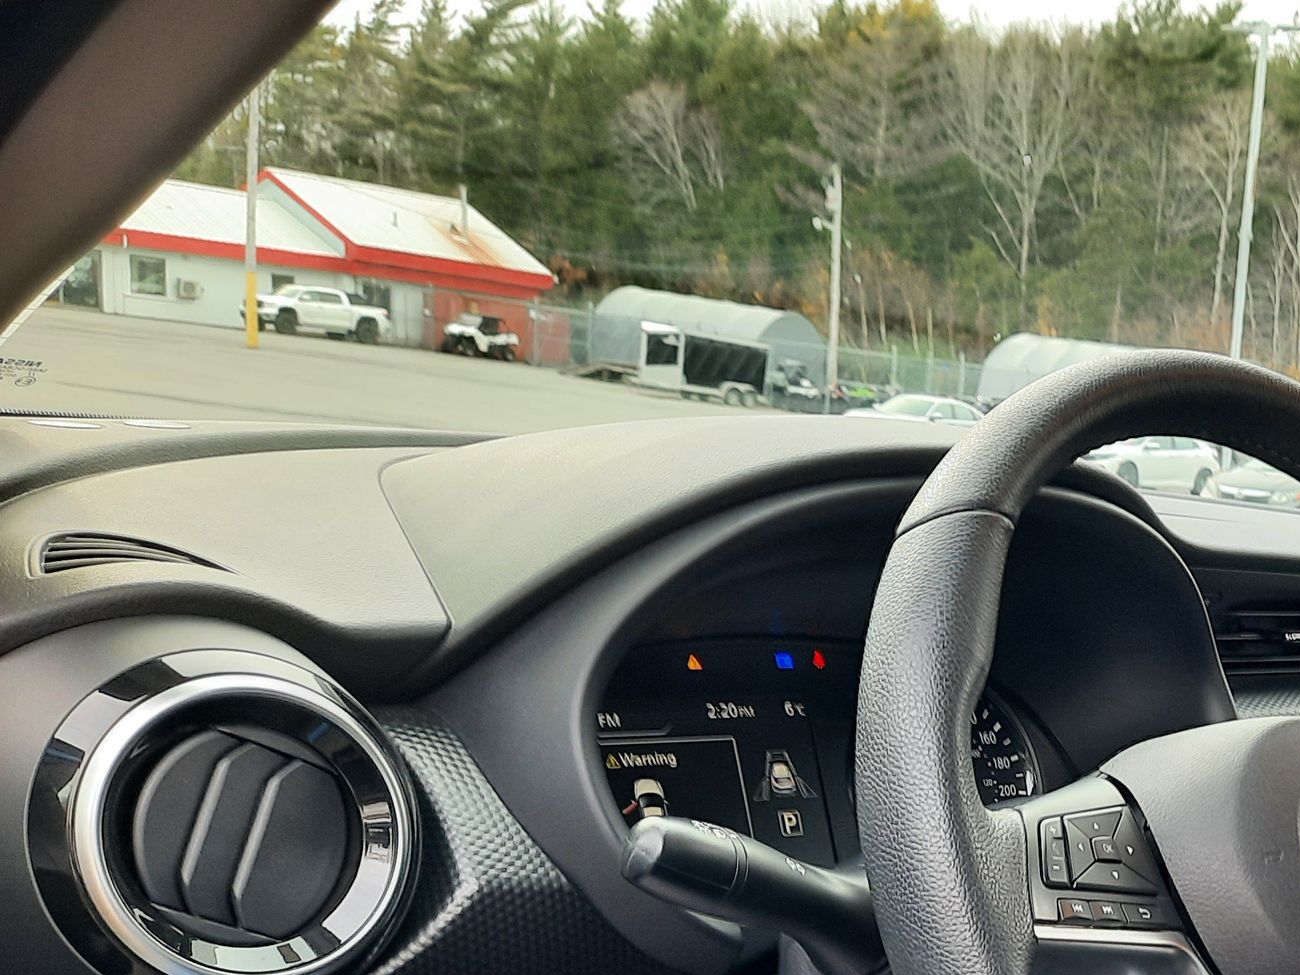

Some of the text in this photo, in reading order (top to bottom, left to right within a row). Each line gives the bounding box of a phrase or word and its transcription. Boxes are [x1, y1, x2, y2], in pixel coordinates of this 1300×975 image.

[979, 730, 997, 745] 160
[618, 751, 678, 769] Warning
[993, 756, 1010, 770] 180
[999, 784, 1017, 797] 200
